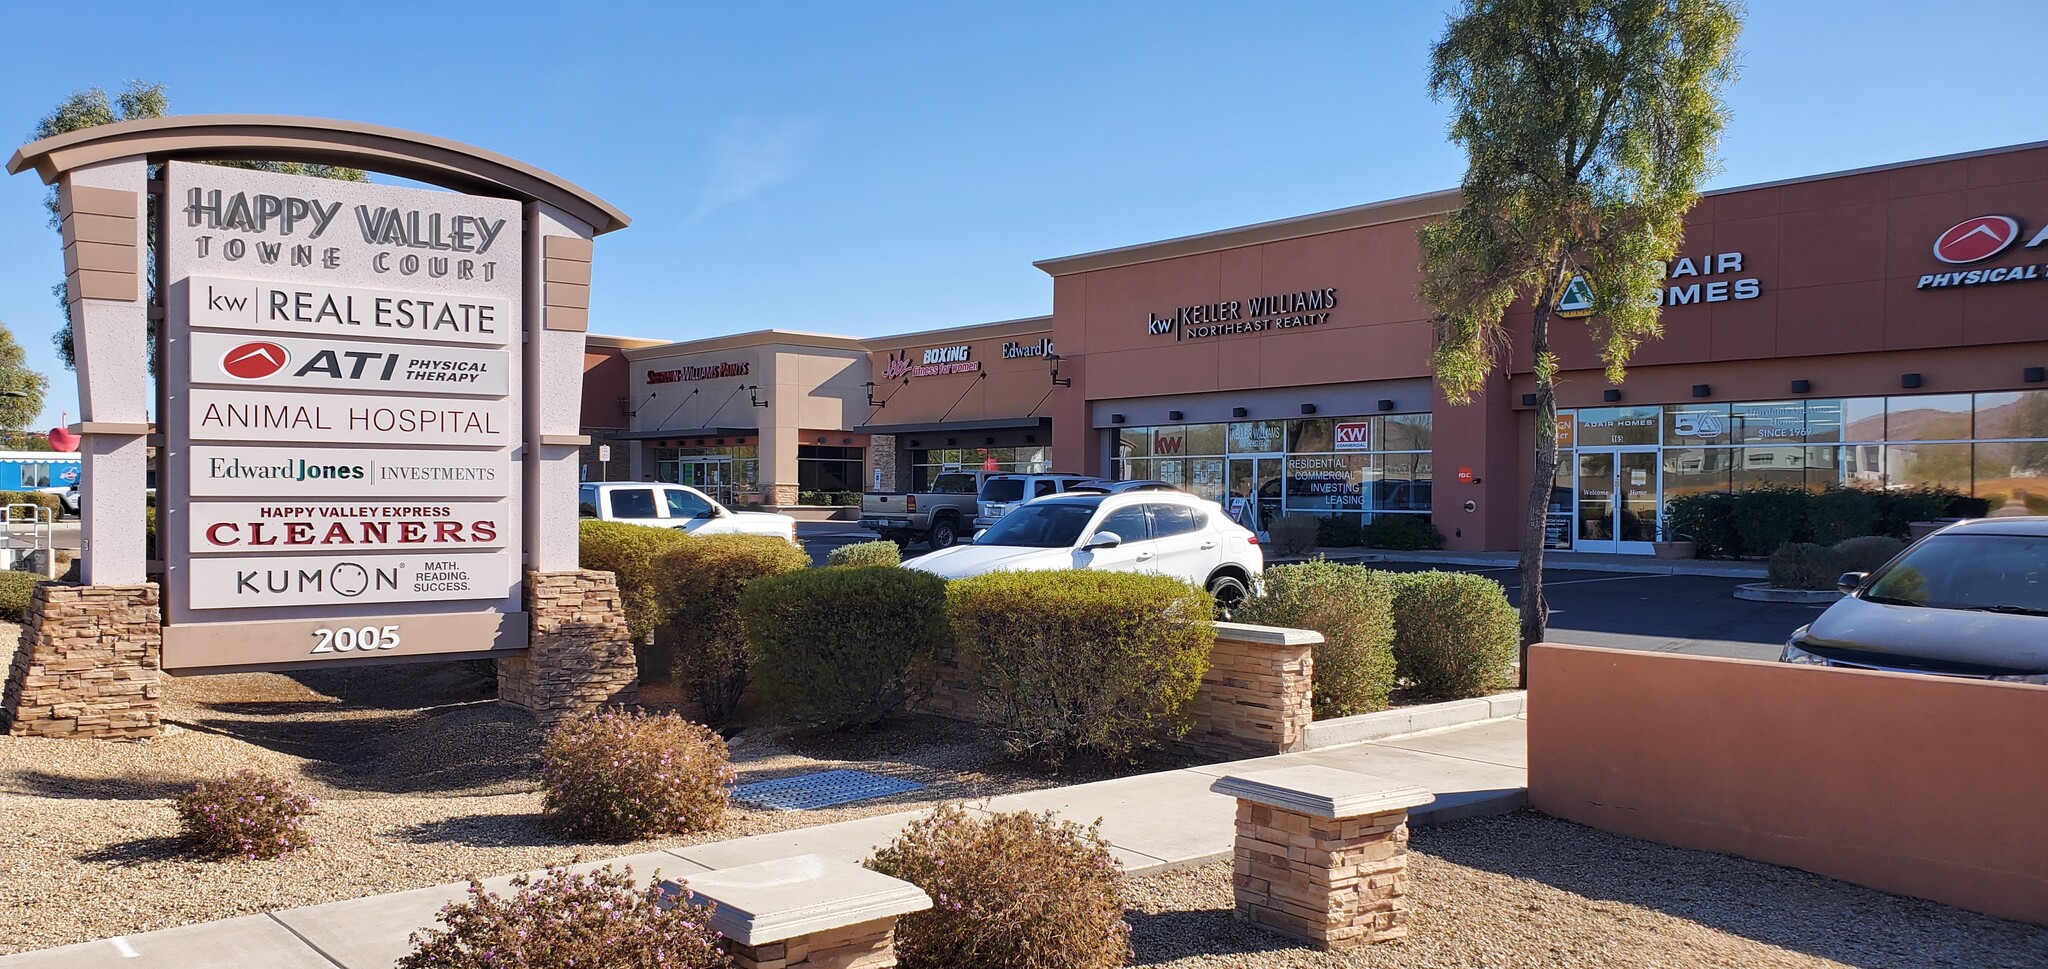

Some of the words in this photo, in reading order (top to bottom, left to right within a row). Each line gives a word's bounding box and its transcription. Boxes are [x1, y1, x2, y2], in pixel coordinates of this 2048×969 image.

[184, 187, 343, 239] HAPPY
[354, 205, 507, 254] VALLEY
[196, 235, 341, 270] TOWNE
[373, 251, 497, 283] COURT
[1916, 264, 2038, 289] PHYSICAL
[1641, 278, 1760, 308] OMES
[208, 286, 247, 312] kw
[270, 290, 361, 325] REAL
[375, 297, 495, 334] ESTATE
[1148, 312, 1174, 335] kw
[1182, 301, 1241, 325] KELLER
[1247, 287, 1337, 317] WILLIAMS
[1186, 319, 1270, 339] NORTHEAST
[1275, 312, 1329, 329] REALTY
[1001, 339, 1042, 359] Edward
[293, 350, 400, 382] ATI
[408, 359, 488, 373] PHYSICAL
[720, 362, 750, 378] PAINTS
[912, 365, 938, 377] fitness
[939, 363, 951, 375] for
[951, 361, 979, 374] women
[405, 370, 480, 383] THERAPY
[201, 404, 332, 431] ANIMAL
[350, 408, 500, 434] HOSPITAL
[1584, 420, 1614, 428] ADAIR
[1231, 428, 1252, 440] KELLER
[1253, 426, 1280, 439] WILLIAMS
[1337, 428, 1366, 442] KW
[1758, 428, 1787, 437] SINCE
[1789, 427, 1813, 436] 1969
[1154, 430, 1182, 454] kw
[208, 457, 295, 479] Edward
[296, 459, 365, 481] Jones
[380, 466, 495, 481] INVESTMENTS
[1289, 458, 1347, 468] RESIDENTIAL
[1295, 471, 1356, 481] COMMERCIAL
[1310, 483, 1360, 493] INVESTING
[1325, 495, 1366, 505] LEASING
[261, 506, 315, 518] HAPPY
[319, 506, 378, 518] VALLEY
[382, 506, 451, 518] EXPRESS
[205, 520, 498, 547] CLEANERS
[424, 561, 460, 571] MATH.
[415, 571, 470, 582] READING.
[413, 582, 471, 592] SUCCESS.
[311, 624, 401, 655] 2005
